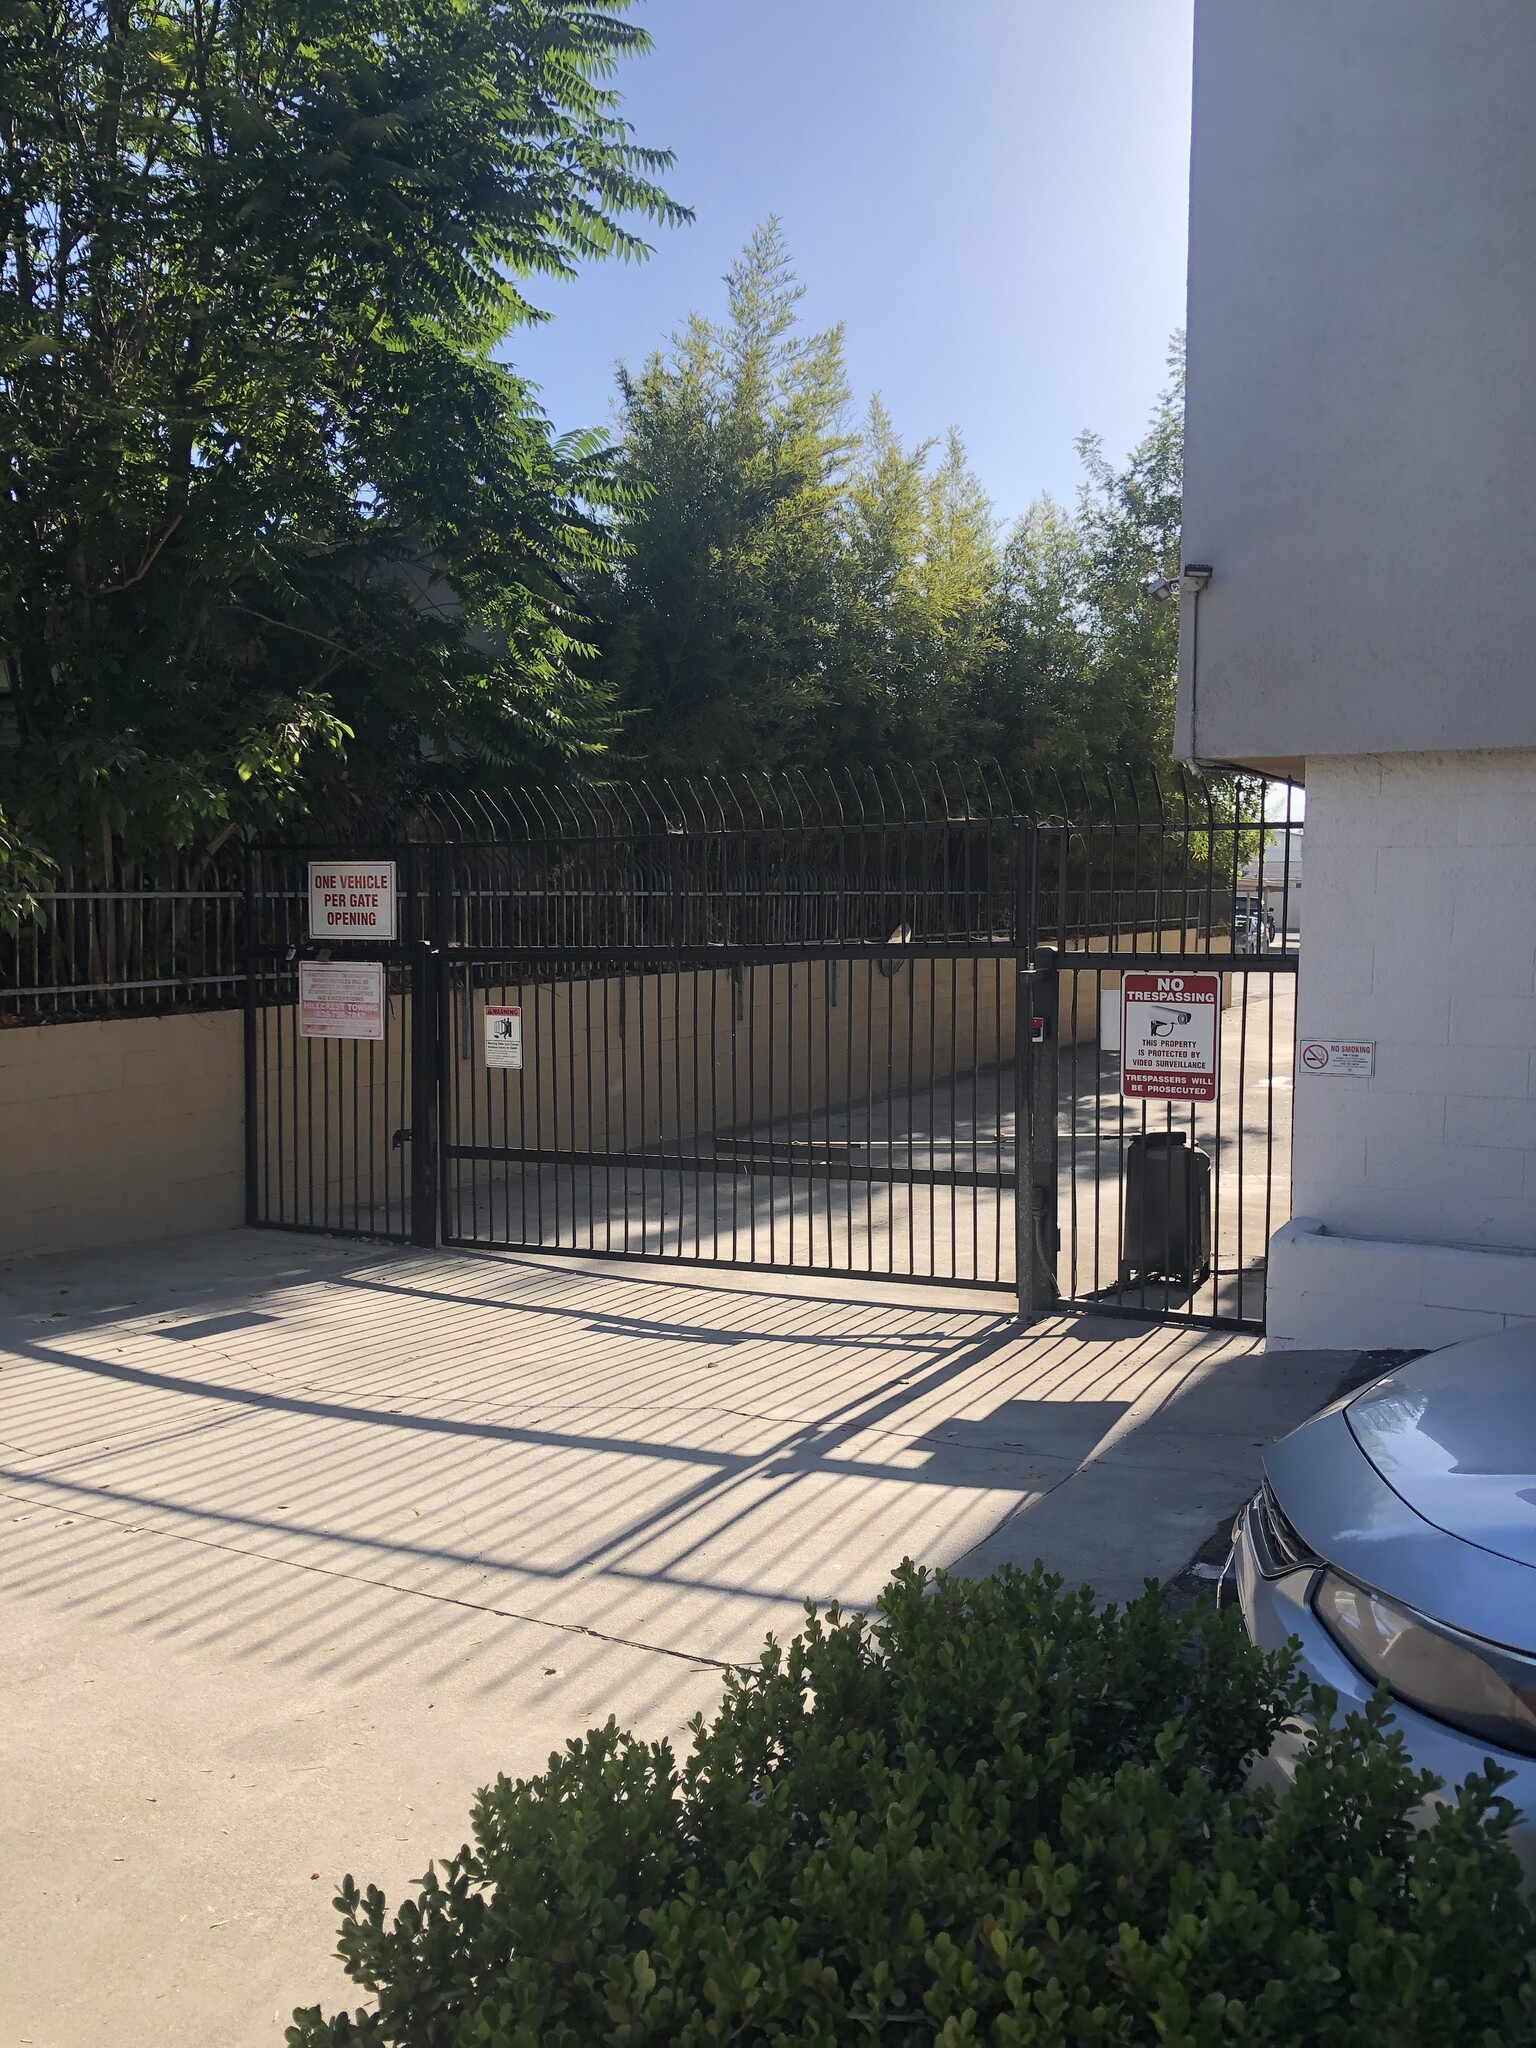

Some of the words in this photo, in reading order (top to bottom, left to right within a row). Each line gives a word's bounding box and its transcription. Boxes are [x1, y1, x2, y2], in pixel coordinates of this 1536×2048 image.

[315, 875, 336, 889] ONE
[340, 875, 388, 889] VEHICLE
[324, 894, 346, 907] PER
[350, 894, 378, 907] GATE
[327, 912, 376, 926] OPENING
[1157, 978, 1184, 991] NO
[1127, 991, 1215, 1002] TRESPASSING
[304, 1002, 345, 1011] HILLCREST
[347, 1004, 379, 1012] TOWING
[1142, 1039, 1158, 1047] THIS
[1160, 1040, 1197, 1048] PROPERTY
[1138, 1049, 1145, 1057] IS
[1148, 1050, 1188, 1058] PROTECTED
[1191, 1051, 1201, 1059] BY
[1341, 1045, 1371, 1054] SMOKING
[1132, 1059, 1153, 1067] VIDEO
[1155, 1060, 1206, 1069] SURVEILLANCE
[1125, 1074, 1187, 1084] TRESPASSERS
[1191, 1077, 1213, 1085] WILL
[1147, 1085, 1207, 1095] PROSECUTED
